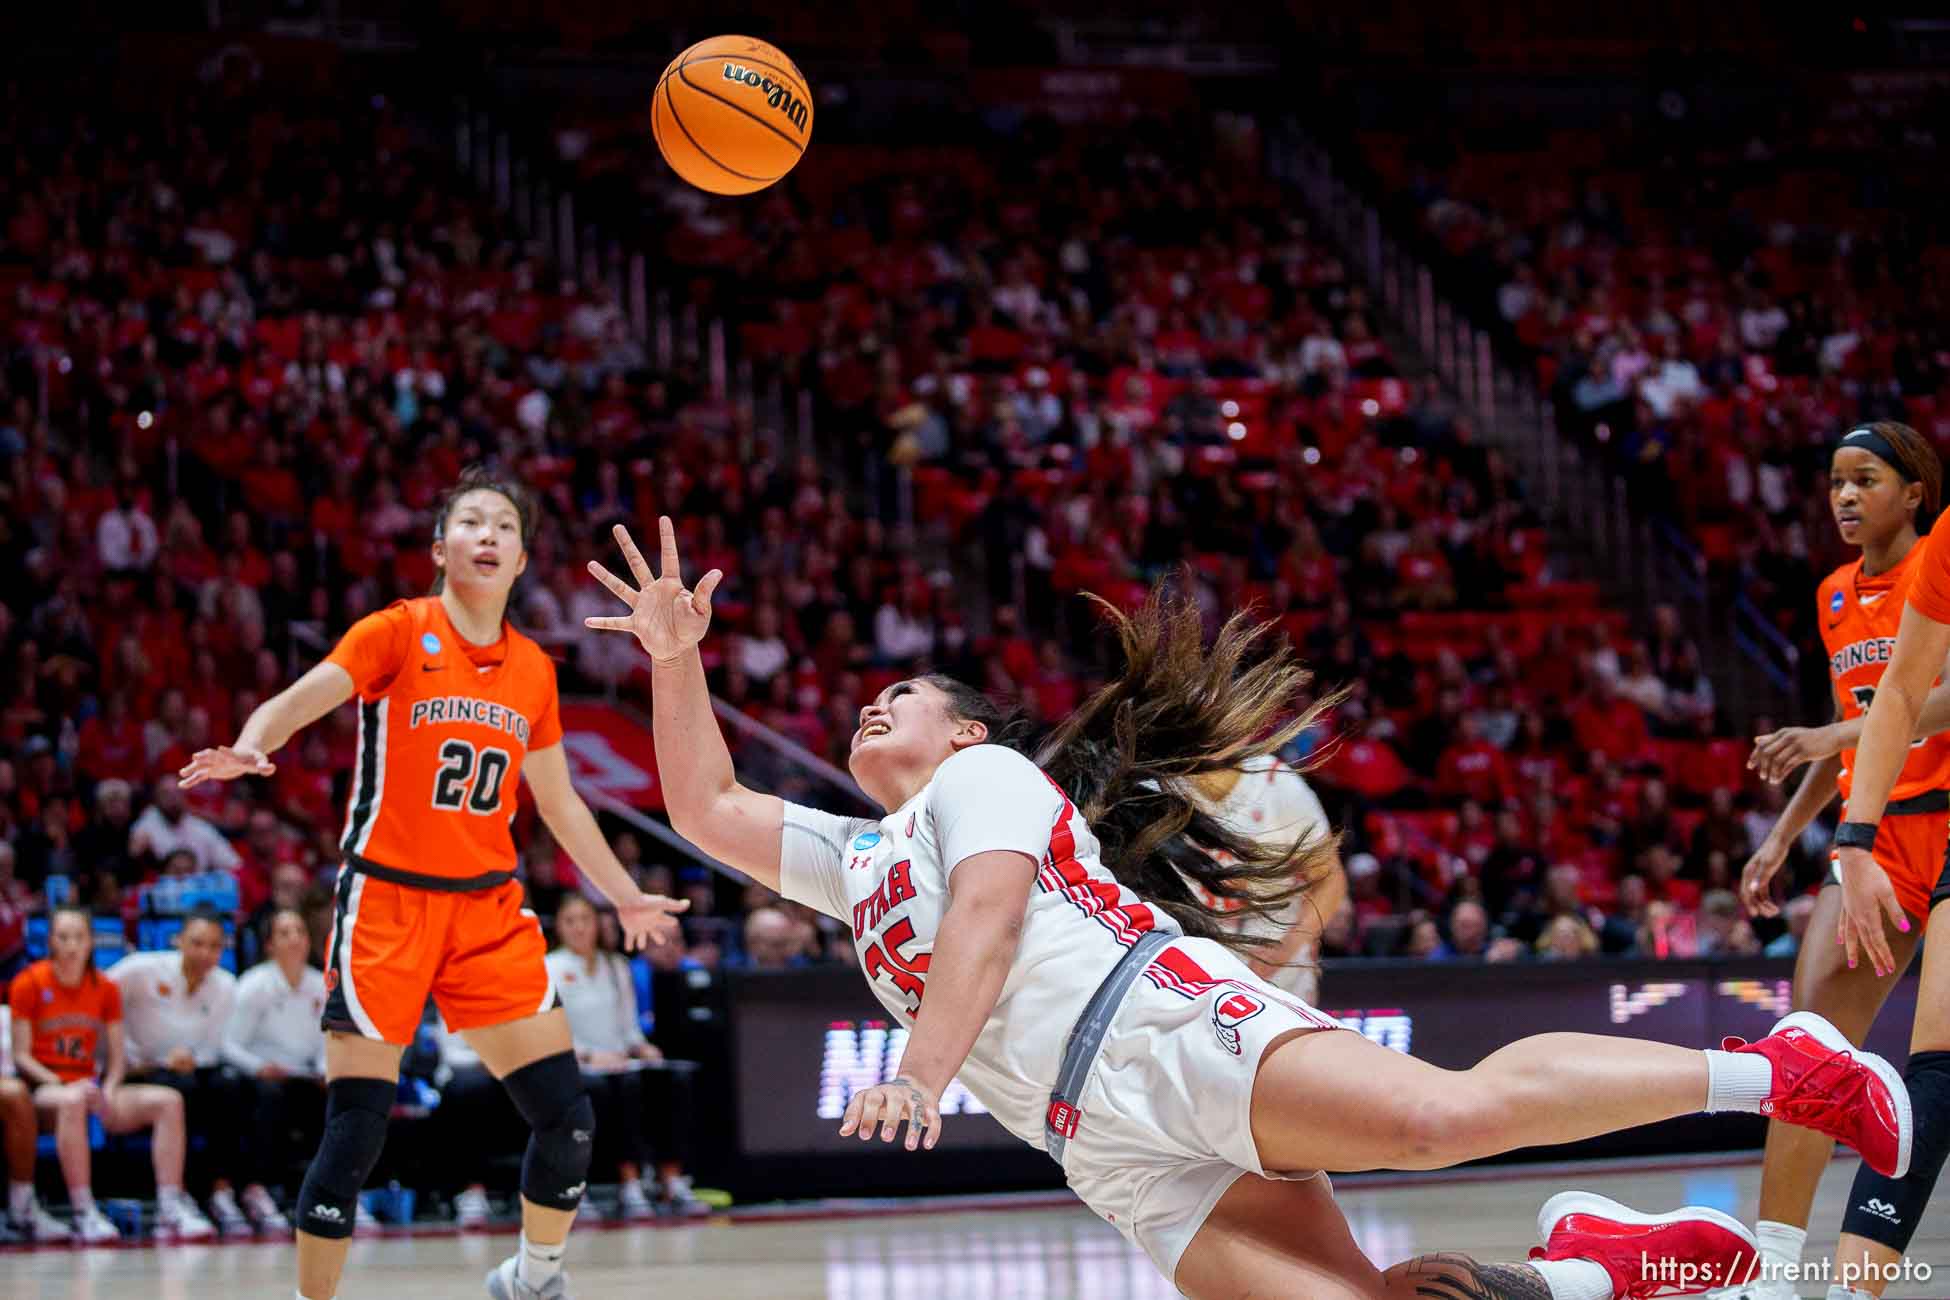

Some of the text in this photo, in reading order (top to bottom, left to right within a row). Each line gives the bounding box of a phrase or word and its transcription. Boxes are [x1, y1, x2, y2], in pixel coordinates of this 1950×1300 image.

[722, 62, 808, 134] Wilson
[410, 695, 529, 746] PRINCETO
[432, 737, 510, 816] 20
[853, 859, 917, 941] UTAH
[1055, 1107, 1069, 1131] UTAH
